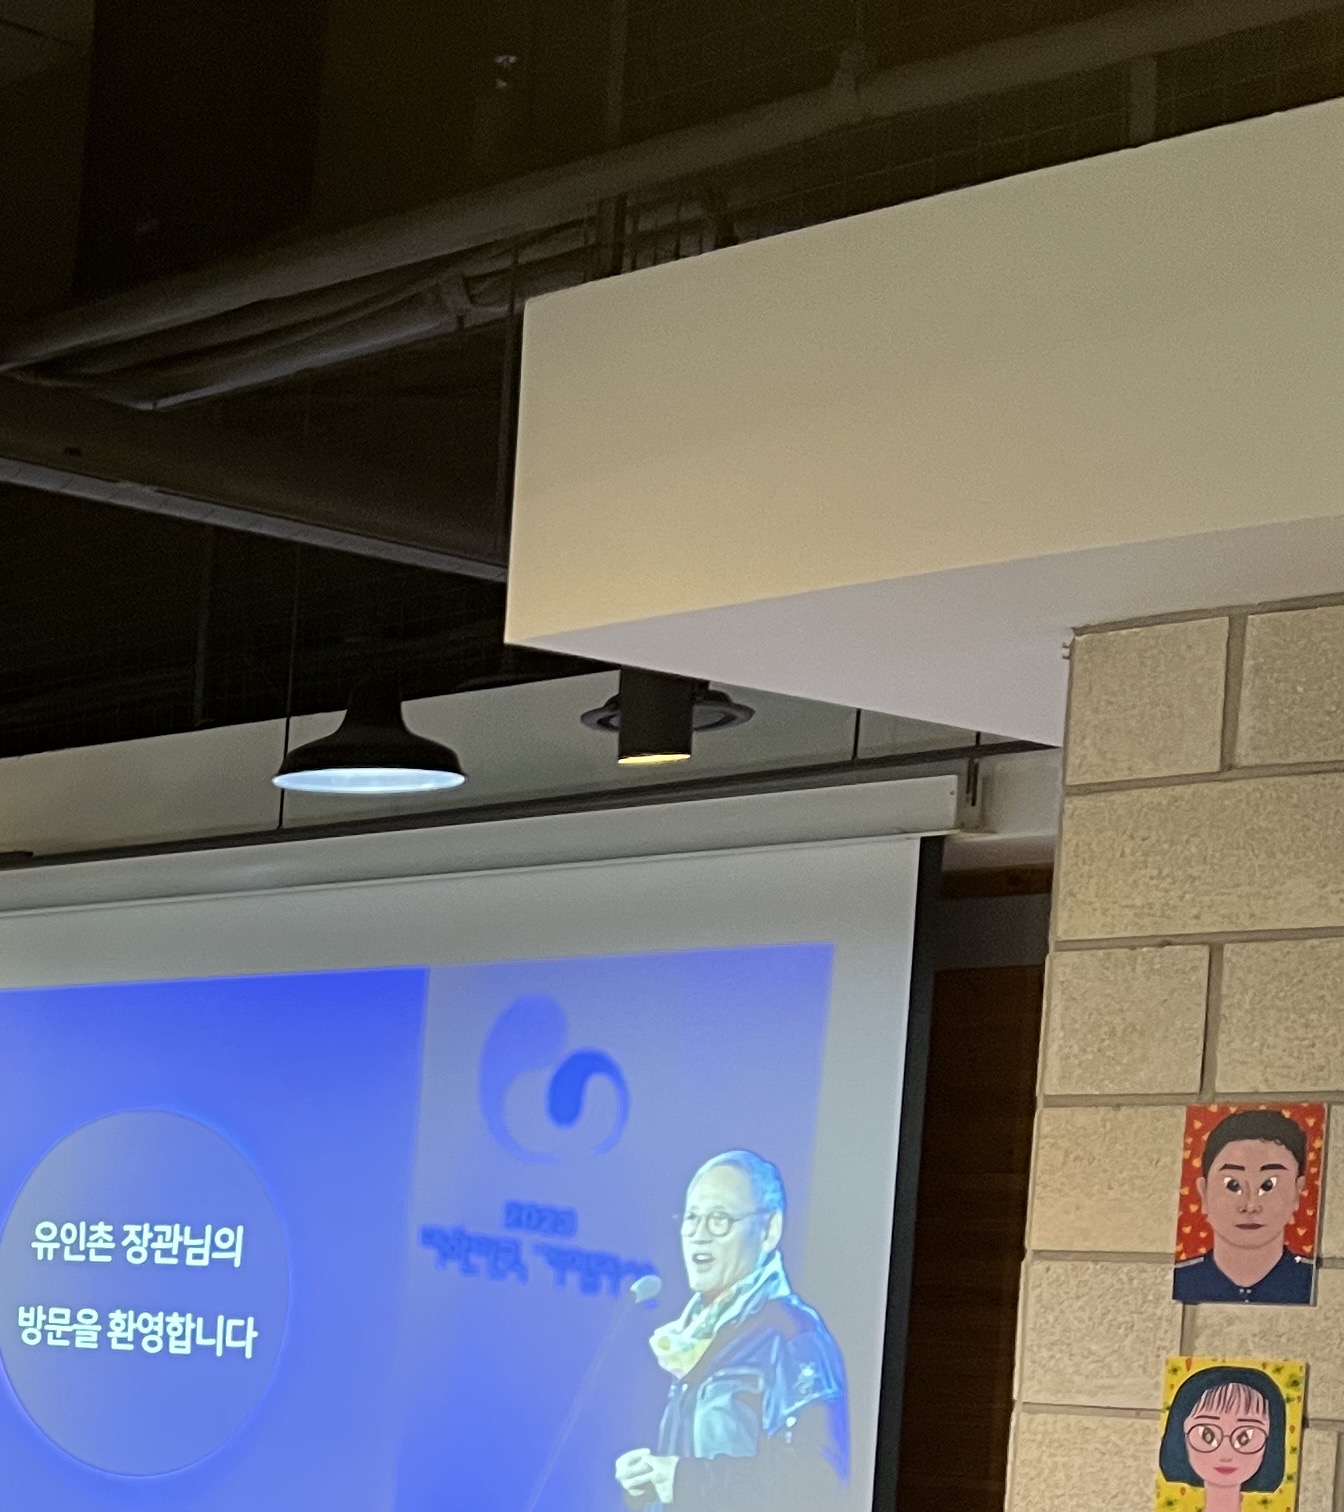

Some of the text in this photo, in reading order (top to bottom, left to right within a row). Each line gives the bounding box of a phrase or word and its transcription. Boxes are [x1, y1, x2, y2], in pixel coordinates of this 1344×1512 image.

[31, 1221, 244, 1268] 유인촌 장관님의
[18, 1305, 259, 1359] 방문을 환영합니다
